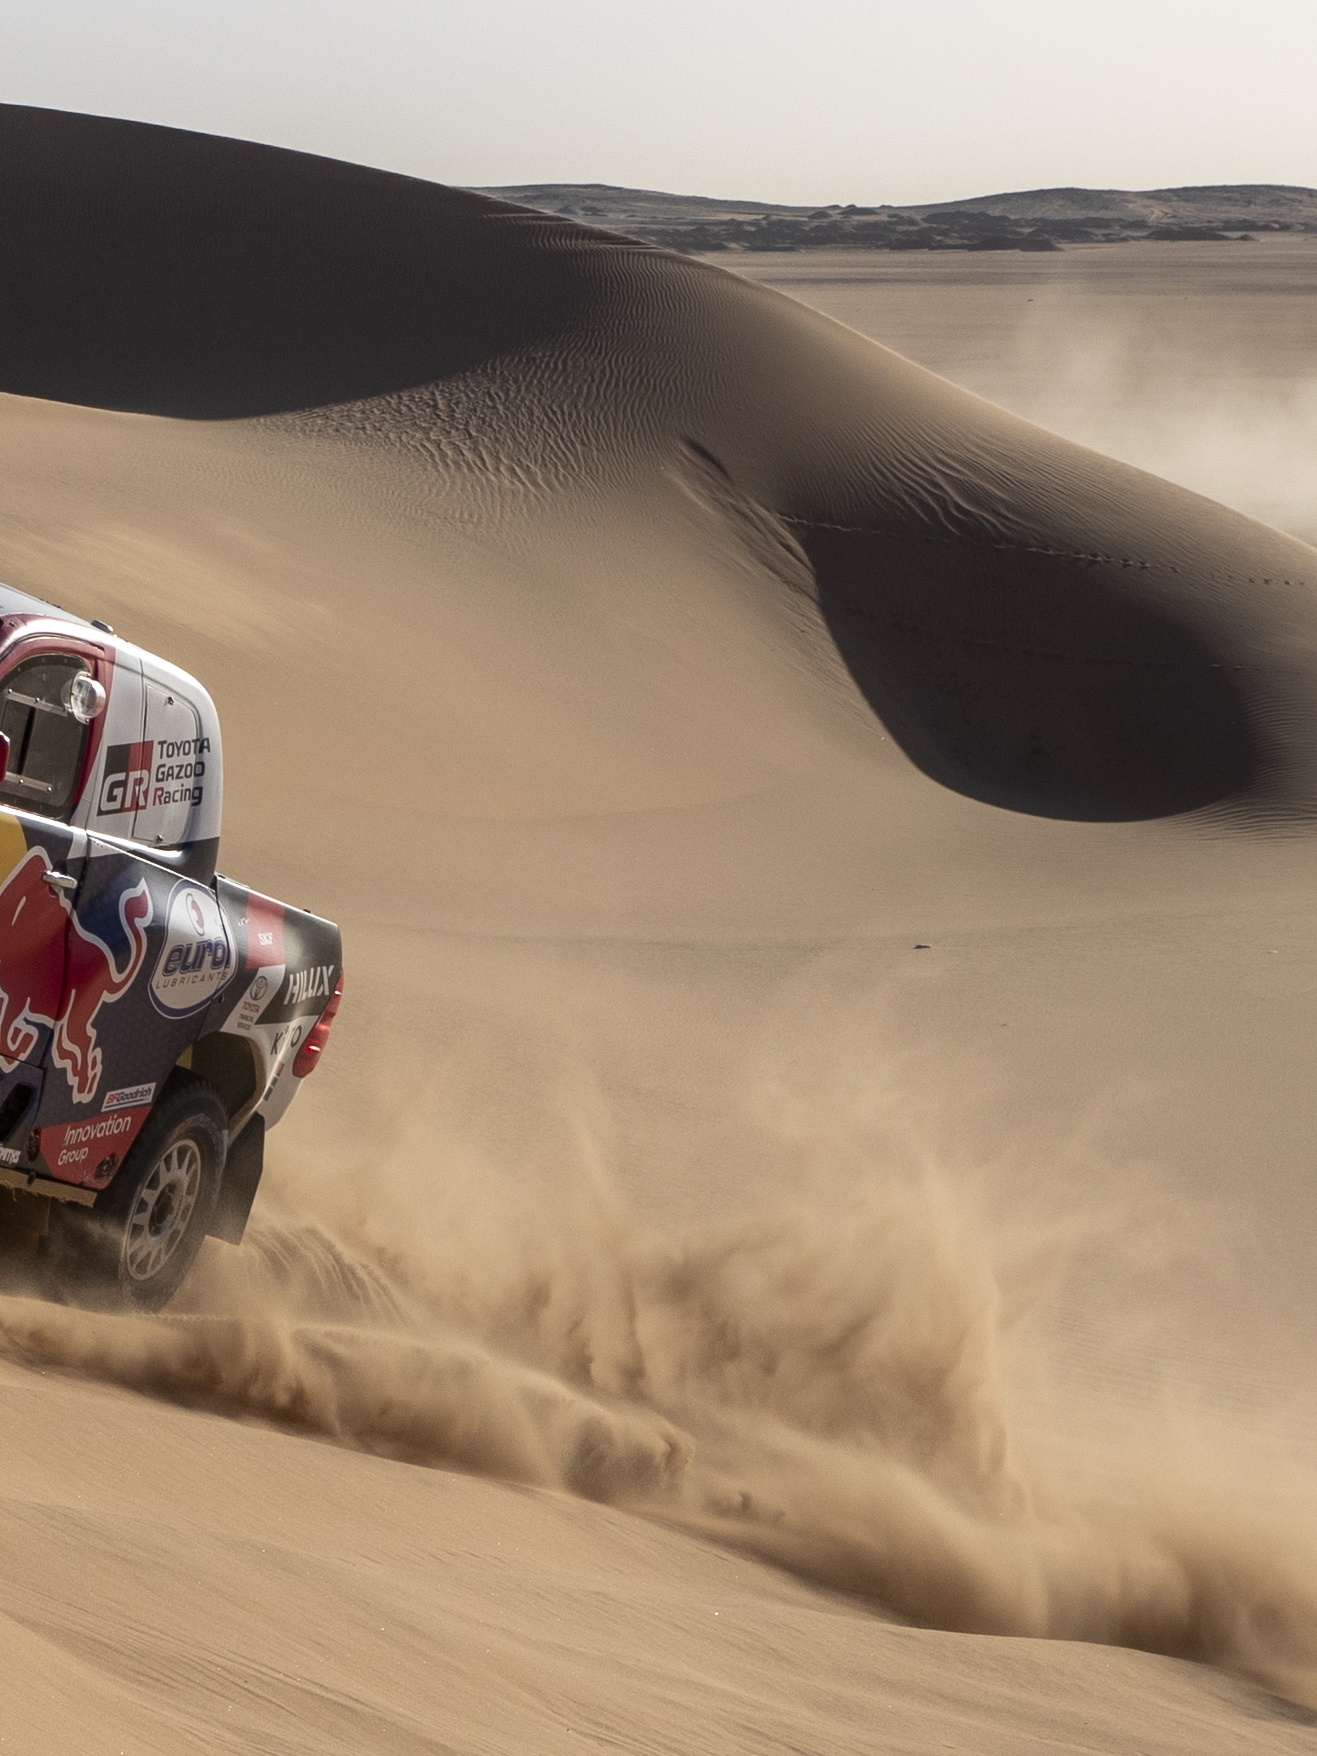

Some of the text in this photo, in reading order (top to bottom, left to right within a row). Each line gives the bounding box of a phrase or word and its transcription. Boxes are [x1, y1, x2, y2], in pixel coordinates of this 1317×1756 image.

[157, 737, 211, 760] TOYOTA
[154, 761, 206, 783] GAZOO
[100, 769, 149, 812] GR
[152, 783, 204, 807] Racing
[105, 1086, 152, 1105] BFGoodrich
[63, 1113, 132, 1147] Innovation
[57, 1146, 89, 1166] Group
